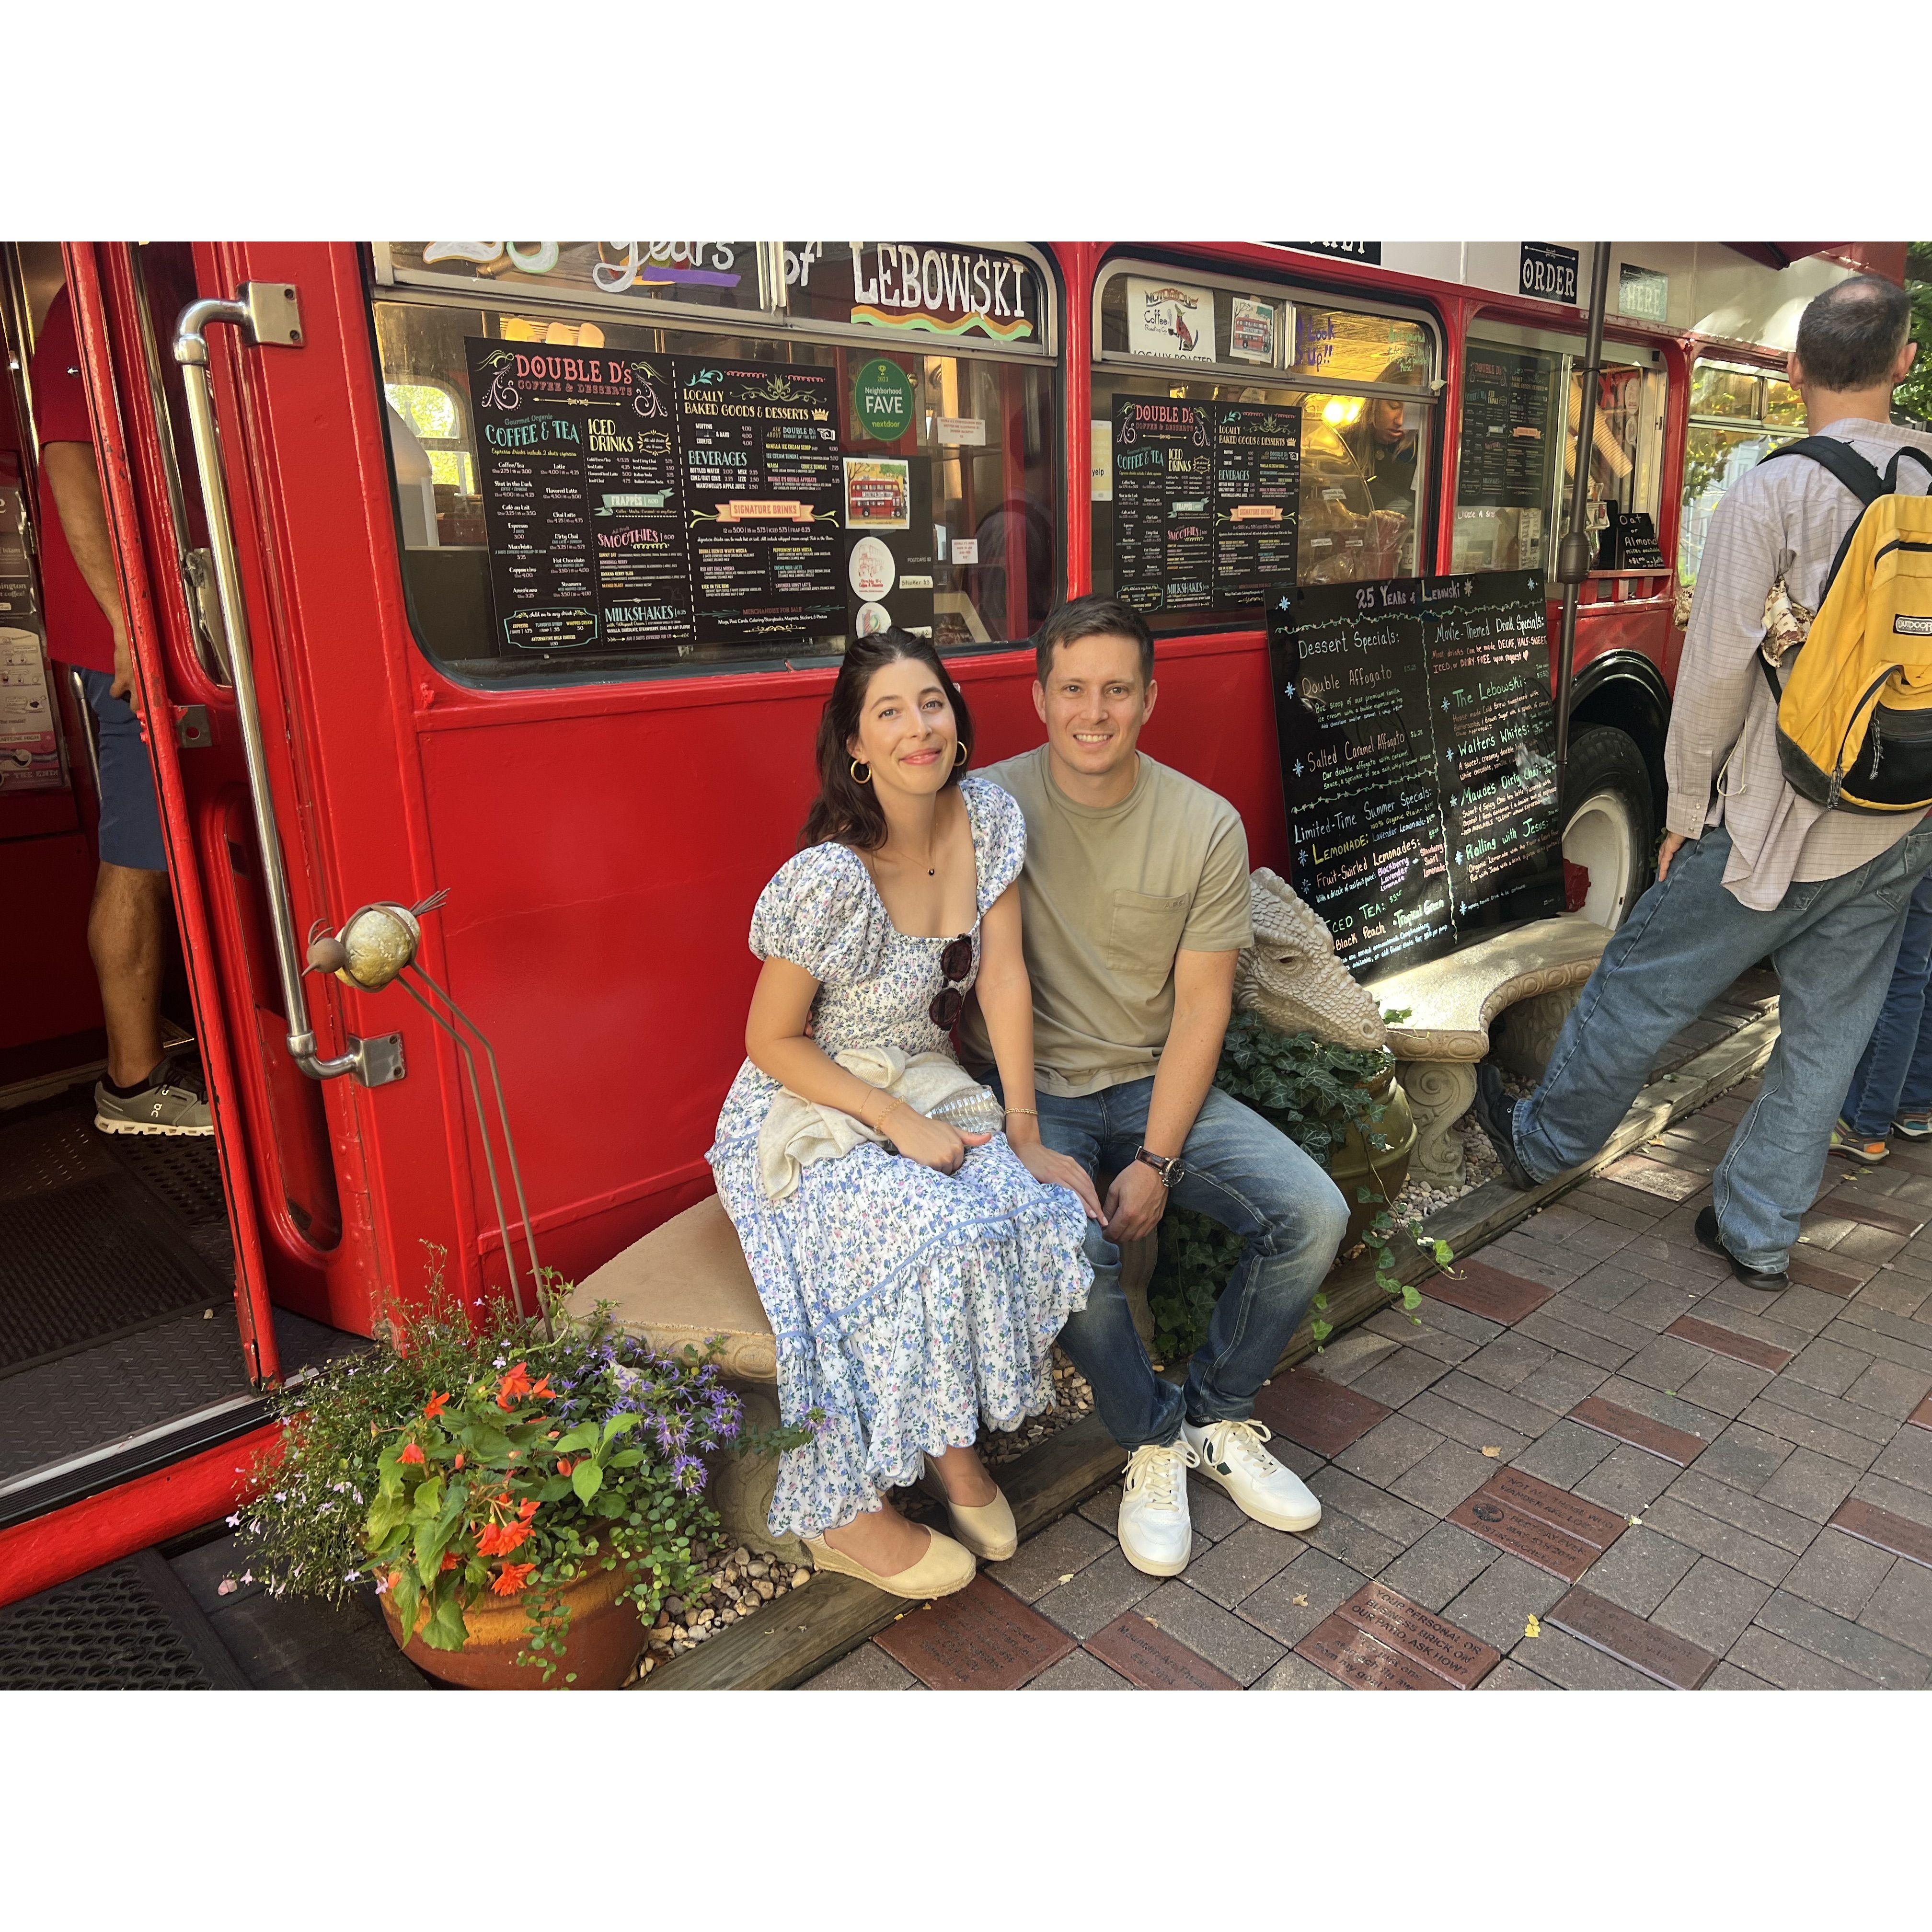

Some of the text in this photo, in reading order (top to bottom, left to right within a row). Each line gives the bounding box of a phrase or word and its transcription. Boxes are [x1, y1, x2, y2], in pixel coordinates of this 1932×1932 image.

[1523, 258, 1575, 297] ORDER
[1626, 283, 1660, 315] HERE
[1145, 310, 1167, 324] Coffee
[1308, 316, 1335, 342] Look
[1308, 345, 1333, 372] Up!!
[514, 354, 632, 385] DOUBLE D's
[1474, 363, 1494, 374] DOUBLE
[517, 380, 632, 396] COFFEE & DESSERTS
[683, 388, 724, 402] LOCALLY
[865, 387, 902, 396] Neighborhood
[685, 402, 808, 420] BAKED GOODS & DESSERTS
[865, 395, 903, 414] FAVE
[1136, 403, 1178, 422] DOUBLE
[505, 413, 553, 426] Gourmet Organic
[588, 419, 616, 435] ICED
[872, 420, 900, 428] nextdoor
[1165, 424, 1194, 432] DESSERTS
[485, 420, 580, 447] COFFEE & TEA
[783, 426, 807, 435] DOUBLE
[1219, 425, 1241, 435] LOCALLY
[589, 435, 633, 452] DRINKS
[1219, 436, 1285, 446] BAKED GOODS DESSERTS
[688, 450, 747, 466] BEVERAGES
[1117, 451, 1144, 470] COFFEE
[1150, 449, 1164, 467] TEA
[1168, 448, 1183, 460] ICED
[1092, 467, 1104, 477] yelp
[1168, 460, 1192, 472] DRINKS
[1219, 470, 1250, 481] BEVERAGES
[611, 494, 642, 506] FRAPPÉS
[734, 505, 797, 514] SIGNATURE DRINKS
[508, 523, 529, 531] Espresso
[1620, 514, 1642, 525] Oat
[598, 529, 658, 548] SMOOTHIES
[1167, 528, 1199, 541] SMOOTHIES
[1625, 533, 1657, 546] Almond
[1167, 583, 1203, 595] MILKSHAKES
[1356, 586, 1375, 609] 25
[605, 605, 674, 622] MILKSHAKES
[1435, 611, 1544, 643] Movie-Themed Drink Specials:
[1298, 626, 1400, 659] Dessert Specials:
[1460, 654, 1491, 667] DAIRY-FREE
[1302, 664, 1392, 695] Double Affogato
[1453, 675, 1527, 708] The Lebowski:
[1458, 725, 1530, 757] Walter's Whites:
[1308, 745, 1337, 772] Salted
[1345, 736, 1374, 760] Caramel
[1322, 771, 1332, 781] Our
[1460, 774, 1521, 806] Maude's Dirty
[1295, 787, 1432, 844] Limited-Time Summer Specials:
[1372, 828, 1397, 842] Lavender
[1465, 817, 1549, 860] Rolling with Jesus:
[1313, 834, 1368, 865] LEMONADE:
[1316, 839, 1420, 888] Fruit-Swirled Lemonades:
[1377, 857, 1410, 876] Blackberry
[1423, 862, 1446, 878] Lemonade
[1380, 866, 1408, 885] Lavender
[1380, 876, 1405, 892] Lemonade
[1359, 903, 1386, 920] TEA:
[1394, 899, 1445, 929] Tropical Green
[1335, 921, 1387, 951] Black Peach
[1506, 1526, 1530, 1538] MAY
[1365, 1599, 1473, 1663] BUSINESS BRICK ON
[1378, 1590, 1482, 1655] YOUR PERSONAL OR
[1352, 1605, 1468, 1675] OUR PATIO, ASK HOW?
[1340, 1658, 1358, 1672] my
[1357, 1672, 1382, 1687] goal
